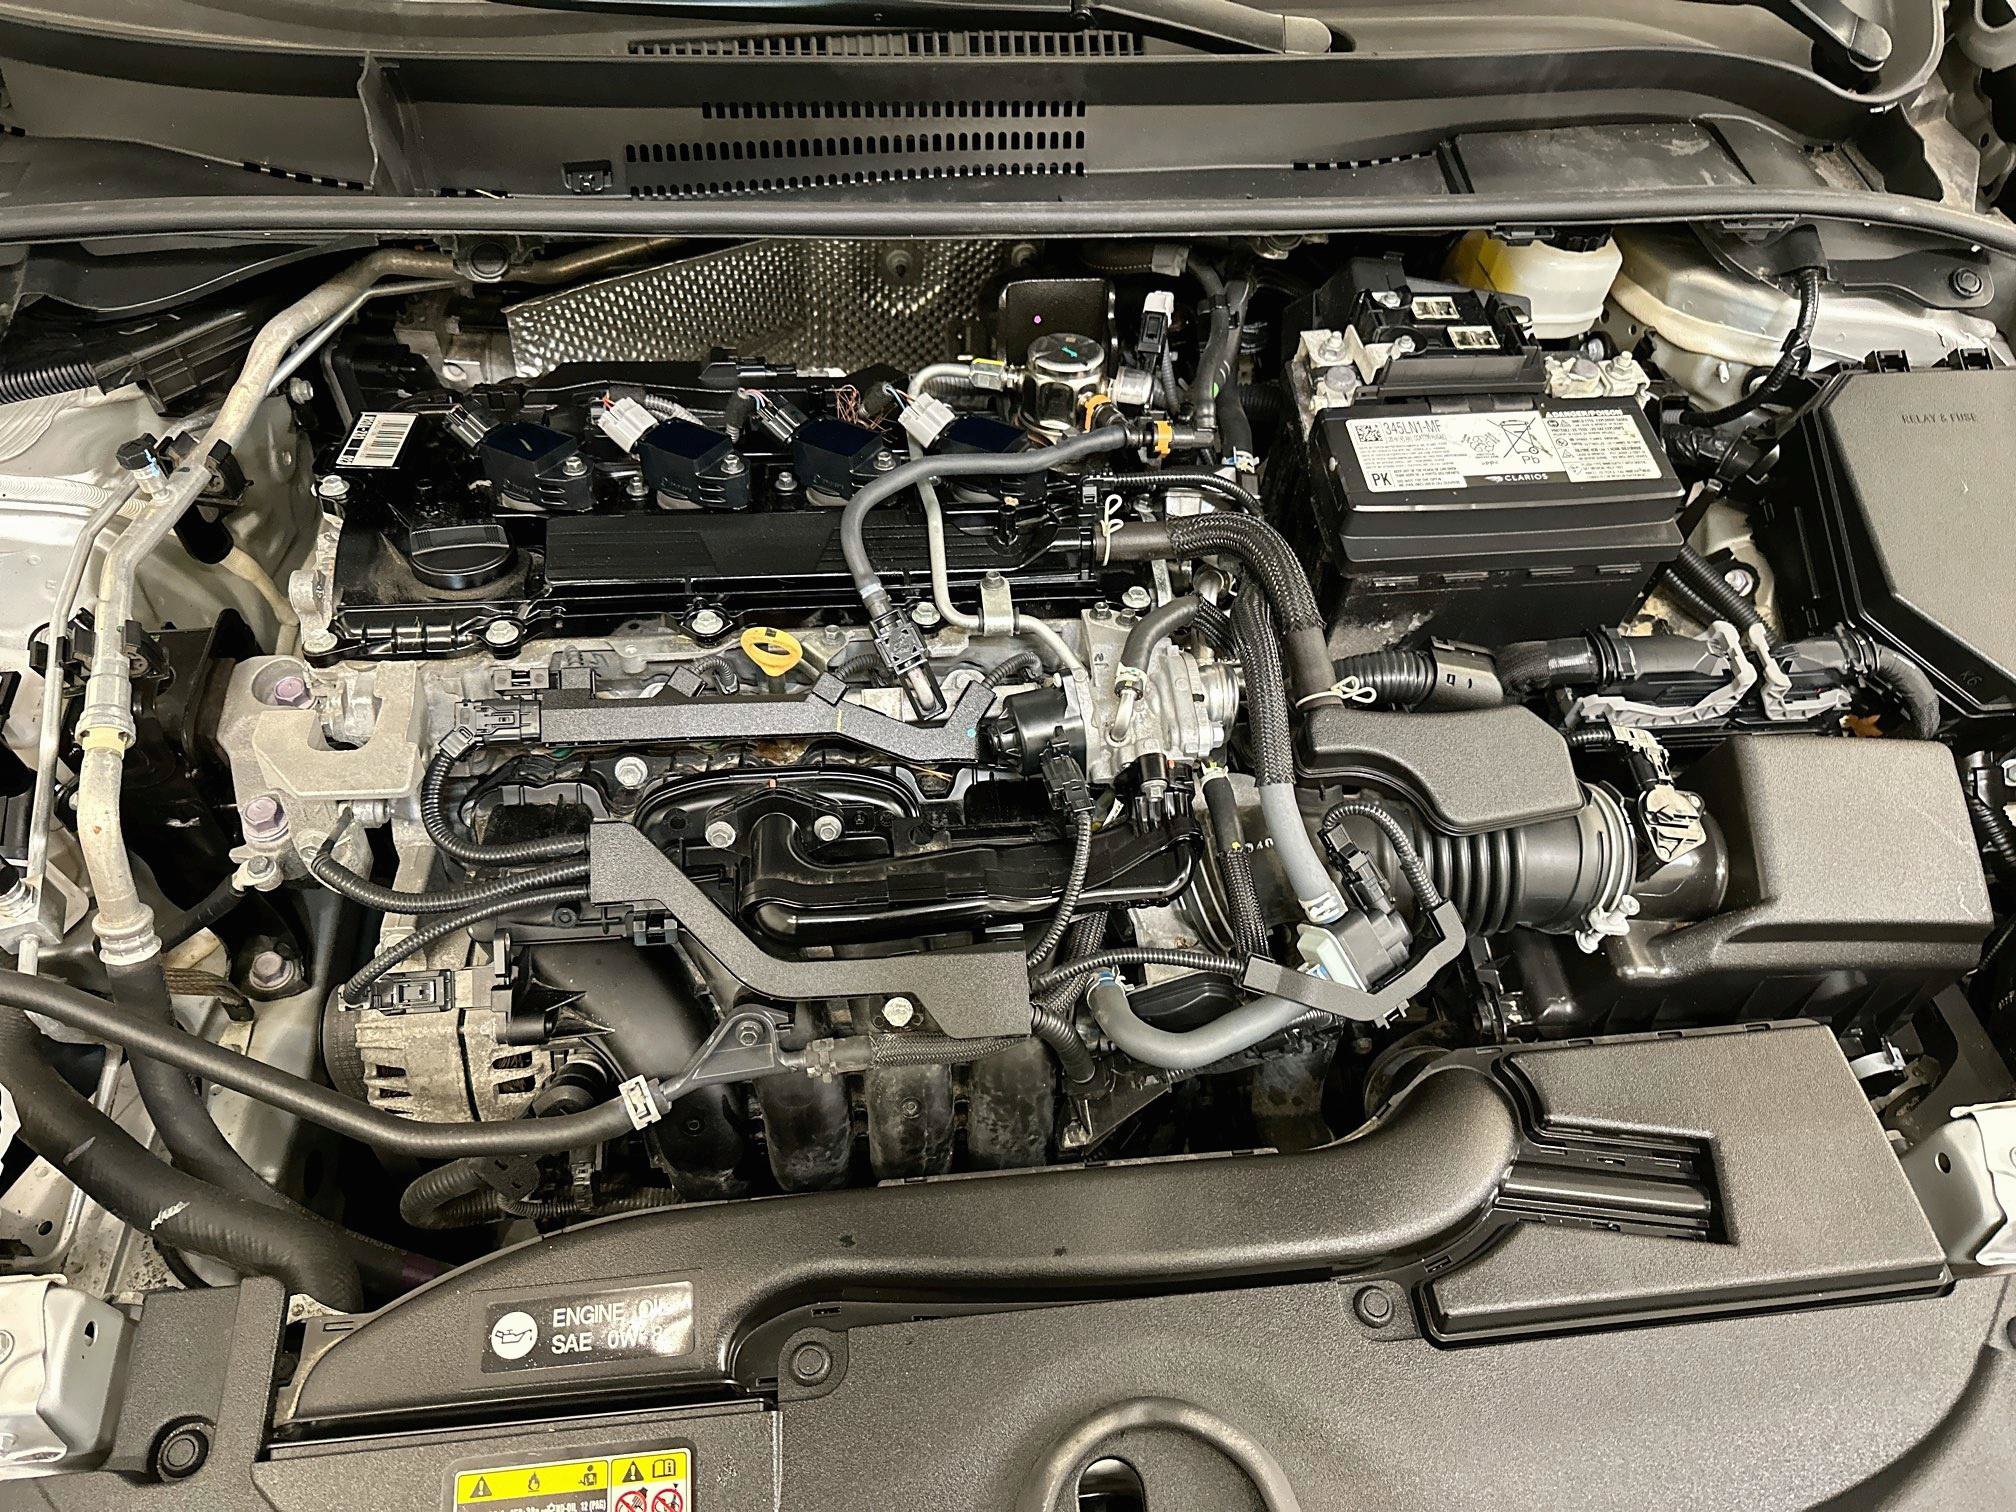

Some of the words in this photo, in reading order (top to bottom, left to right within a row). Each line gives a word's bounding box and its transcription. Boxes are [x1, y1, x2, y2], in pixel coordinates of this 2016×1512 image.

[1383, 419, 1441, 435] 345LN1-MF
[1521, 455, 1541, 465] Pb
[1372, 472, 1392, 487] PK
[1504, 473, 1549, 482] CLARIOS
[553, 1302, 625, 1328] ENGINE
[551, 1332, 593, 1355] SAE
